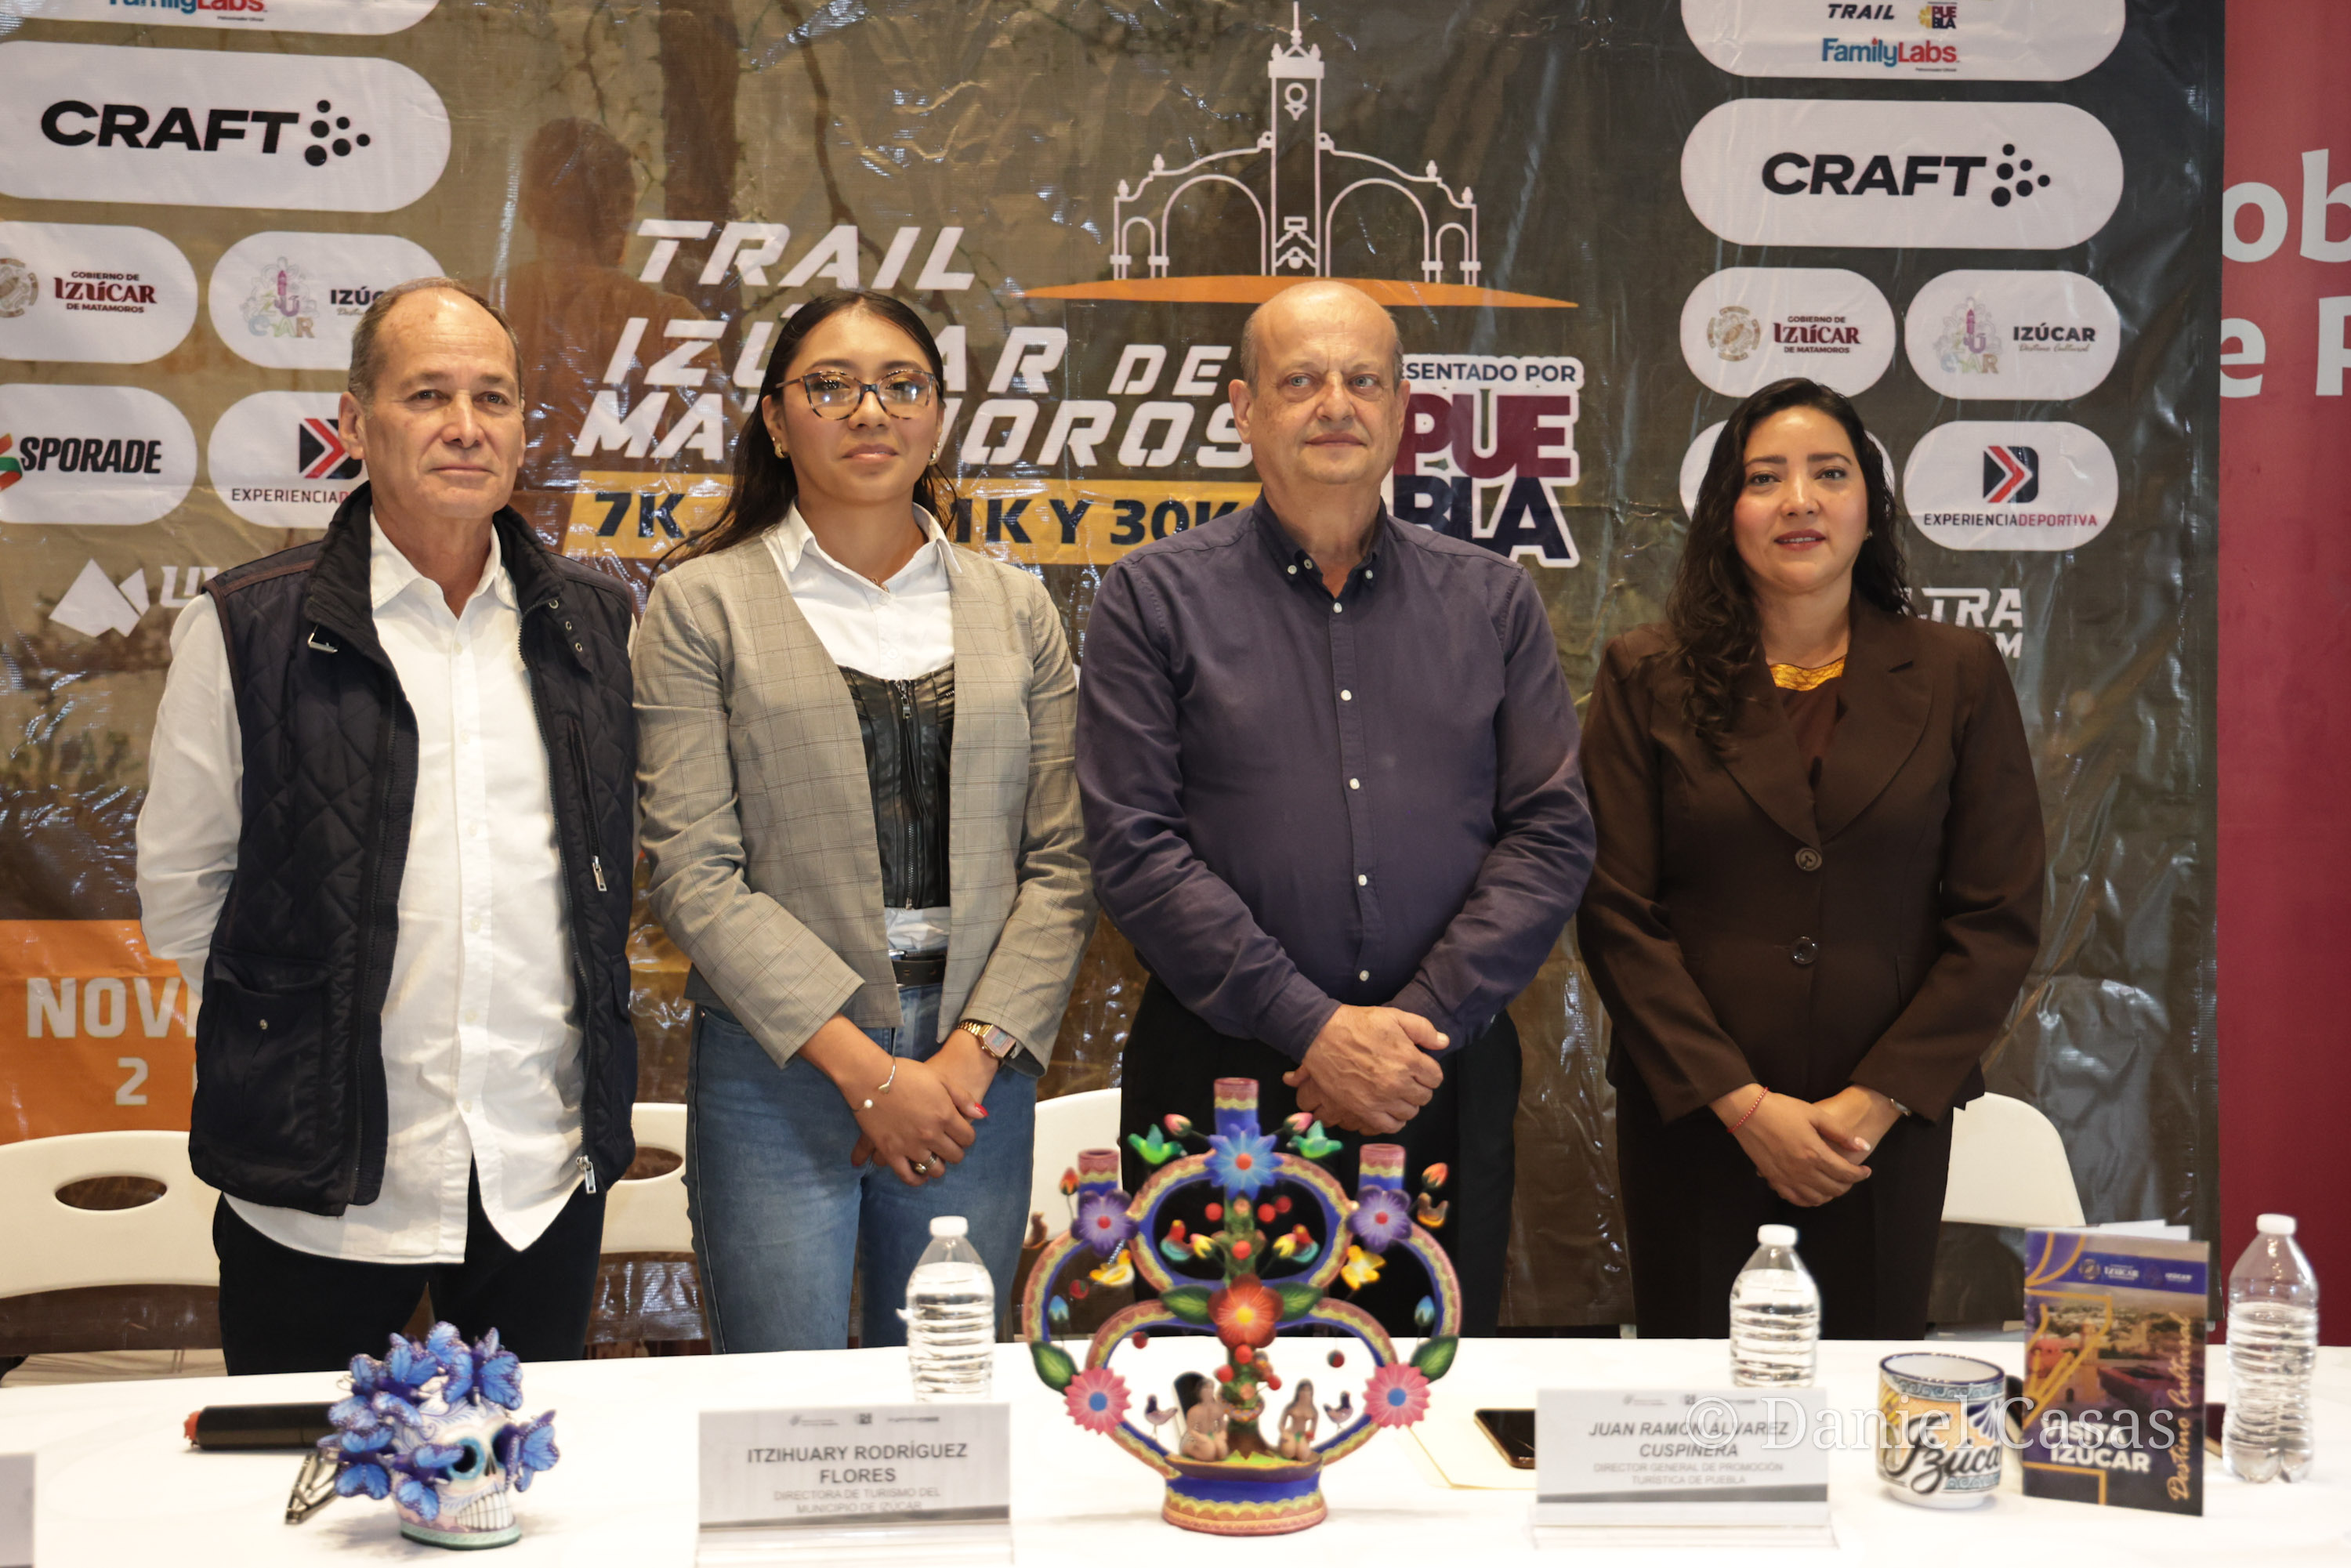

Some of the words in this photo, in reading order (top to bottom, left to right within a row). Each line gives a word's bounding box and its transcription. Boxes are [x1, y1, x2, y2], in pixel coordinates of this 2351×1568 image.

[1828, 4, 1895, 20] TRAIL
[1932, 5, 1957, 18] PUE
[1932, 17, 1957, 29] BLA
[1822, 38, 1957, 67] FamilyLabs
[42, 100, 299, 154] CRAFT
[1762, 151, 1987, 197] CRAFT
[636, 219, 975, 290] TRAIL
[71, 271, 123, 281] GOBIERNO
[82, 304, 144, 313] MATAMOROS
[2013, 322, 2096, 342] IZÚCAR
[1107, 344, 1232, 395] DE
[1403, 363, 1517, 382] SENTADO
[1526, 364, 1576, 382] POR
[1393, 393, 1571, 480] PUE
[20, 436, 161, 475] SPORADE
[232, 488, 352, 504] EXPERIENCIAD
[1048, 499, 1094, 544] Y
[1924, 513, 2098, 527] EXPERIENCIADEPORTIVA
[115, 1057, 149, 1106] 2
[2167, 1311, 2192, 1409] Cultural
[1588, 1422, 1635, 1436] JUAN
[747, 1446, 849, 1464] ITZIHUARY
[853, 1440, 969, 1461] RODRÍGUEZ
[1639, 1443, 1739, 1458] CUSPINERA
[2167, 1417, 2192, 1501] Destino
[820, 1468, 897, 1484] FLORES
[1593, 1463, 1647, 1473] DIRECTOR
[1650, 1462, 1698, 1472] GENERAL
[1702, 1462, 1715, 1472] DE
[1688, 1475, 1702, 1484] DE
[1705, 1475, 1745, 1484] PUEBLA
[773, 1489, 841, 1501] DIRECTORA
[844, 1489, 859, 1498] DE
[864, 1488, 915, 1498] TURISMO
[918, 1487, 940, 1497] DEL
[796, 1502, 857, 1513] MUNICIPIO
[861, 1502, 877, 1512] DE
